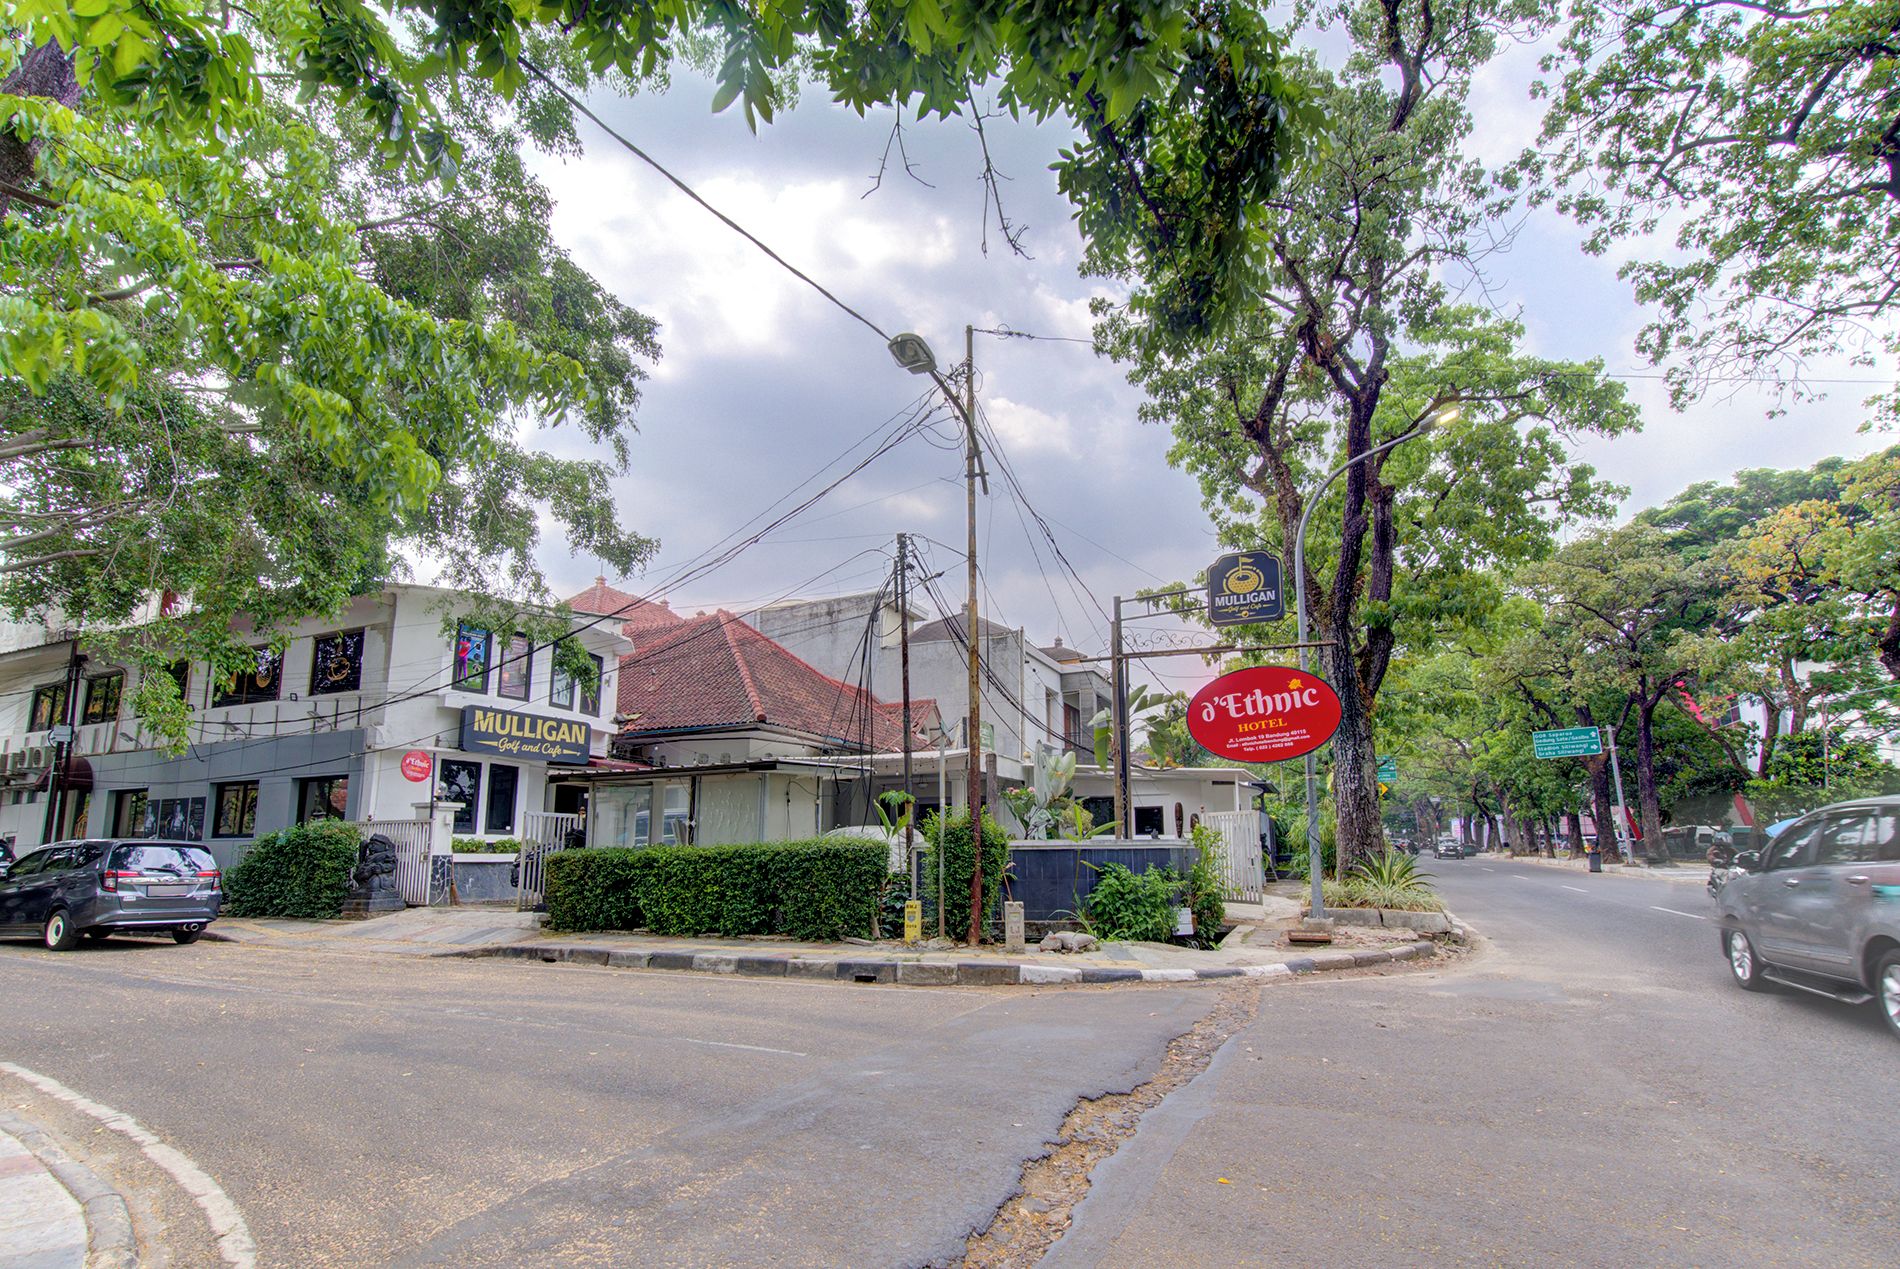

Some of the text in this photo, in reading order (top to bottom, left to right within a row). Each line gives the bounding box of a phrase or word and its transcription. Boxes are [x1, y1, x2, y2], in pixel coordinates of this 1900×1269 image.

[1215, 590, 1276, 607] MULLIGAN
[1201, 688, 1320, 722] d'Ethnic
[474, 709, 586, 744] MULLIGAN
[1238, 718, 1288, 733] HOTEL
[498, 737, 562, 758] Golf and Cafe
